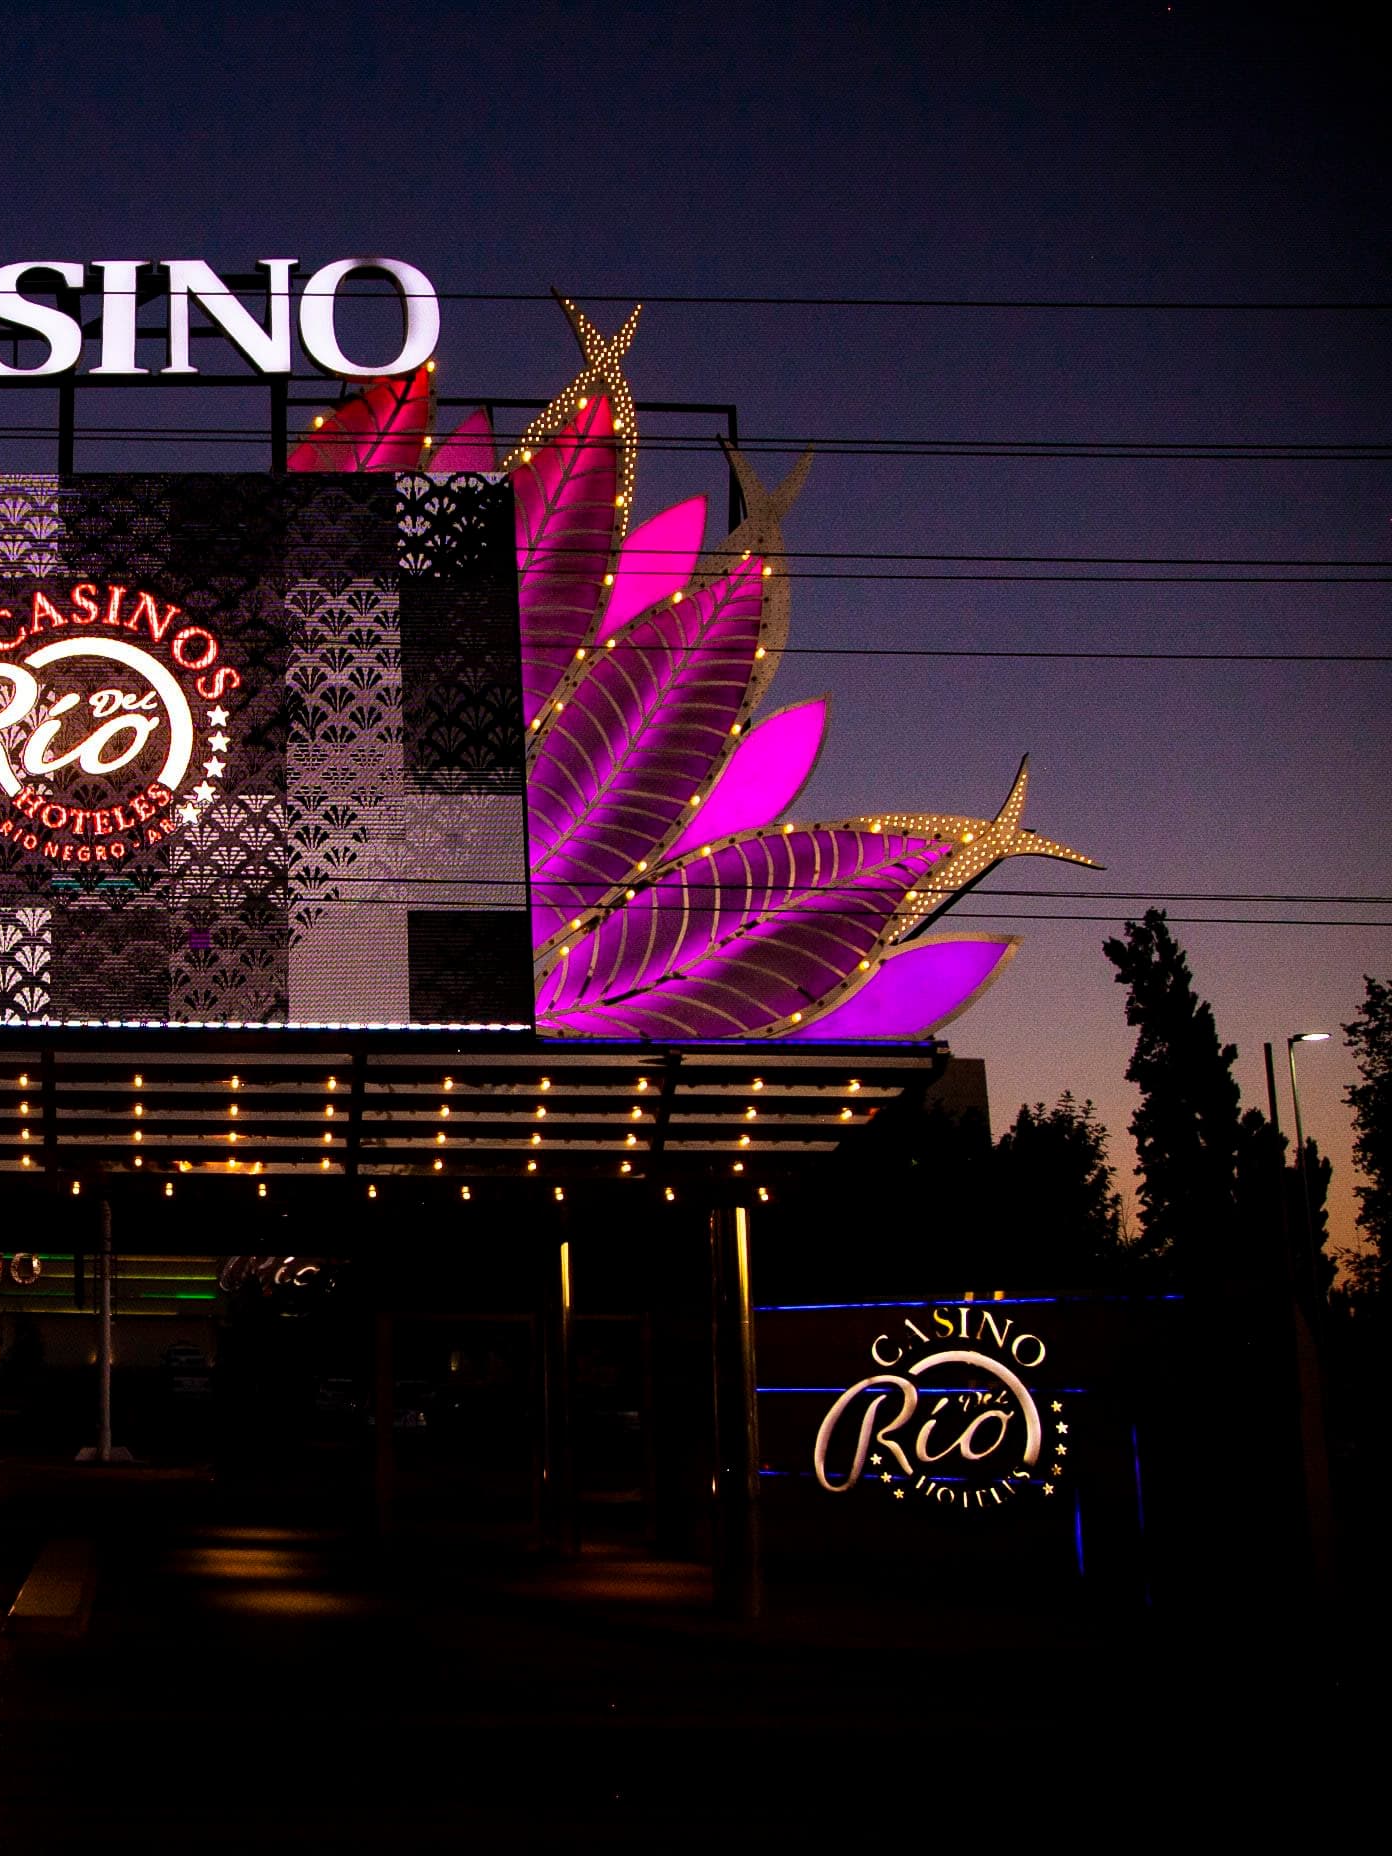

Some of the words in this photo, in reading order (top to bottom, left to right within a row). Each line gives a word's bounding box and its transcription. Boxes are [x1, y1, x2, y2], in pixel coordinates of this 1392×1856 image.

[89, 689, 159, 718] Del
[12, 781, 173, 836] HOTELES
[44, 841, 126, 862] NEGRO
[871, 1307, 1046, 1367] CASINO
